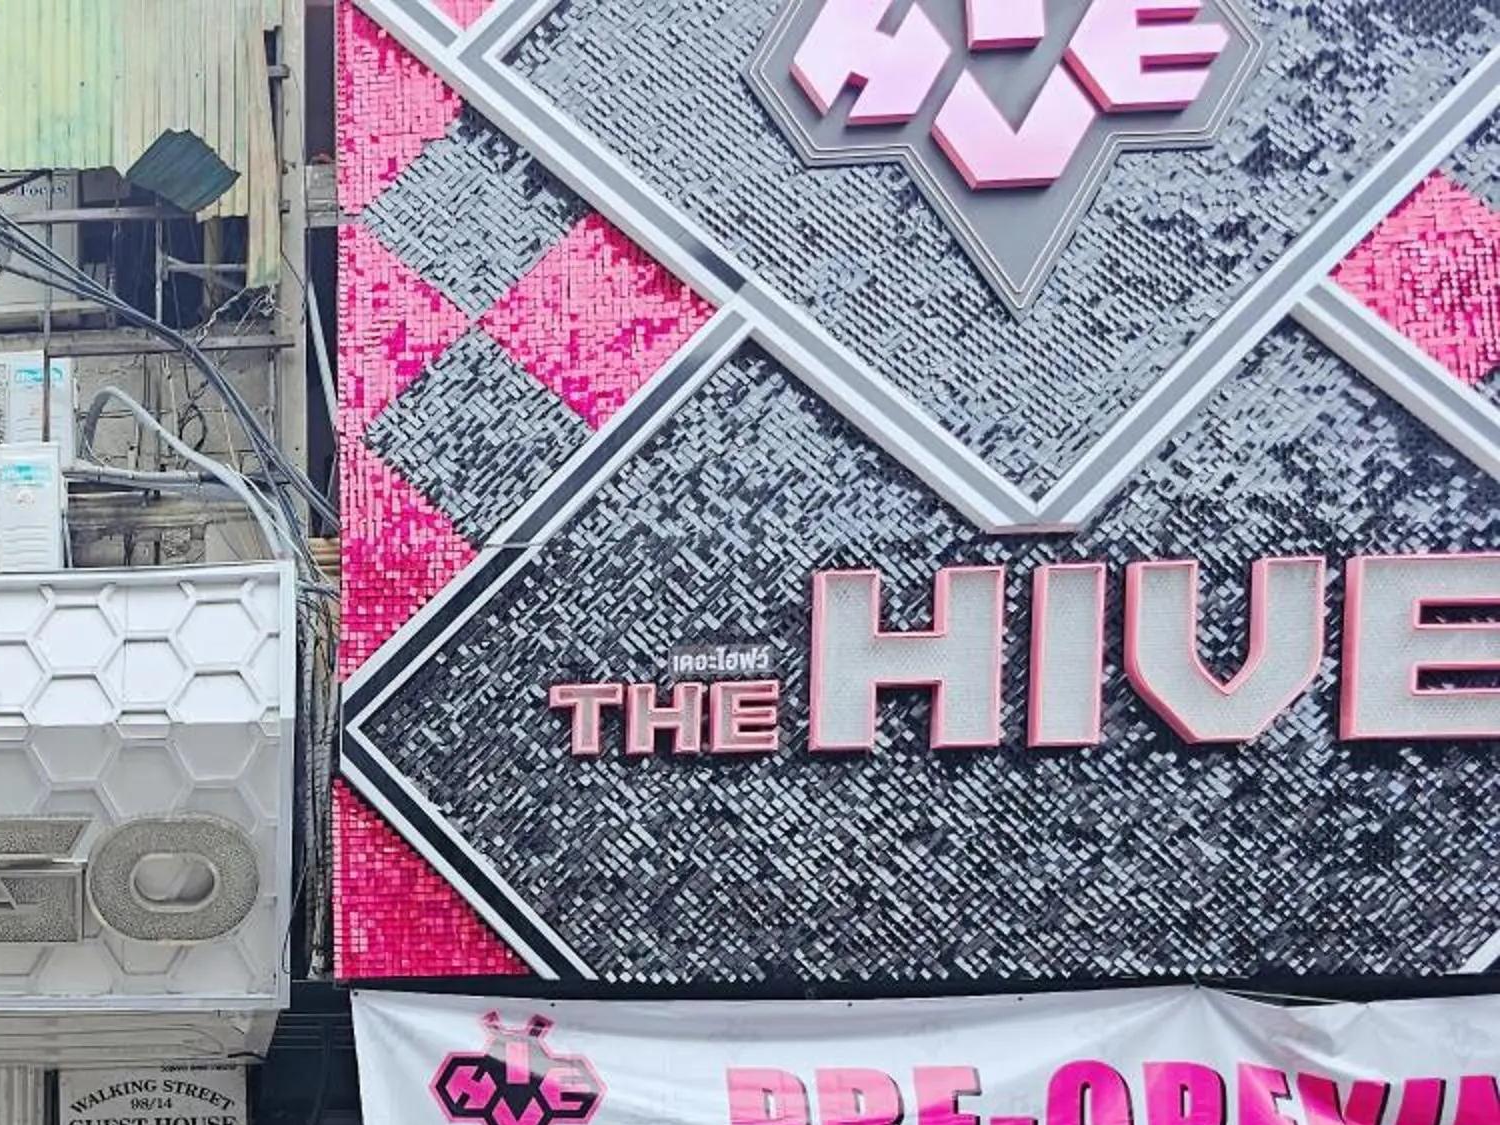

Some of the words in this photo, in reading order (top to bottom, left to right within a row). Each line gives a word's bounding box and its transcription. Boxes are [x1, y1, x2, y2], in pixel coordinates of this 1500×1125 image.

[549, 680, 780, 755] THE
[808, 553, 1500, 753] HIVE
[69, 1080, 158, 1114] WALKING
[162, 1079, 236, 1113] STREET
[130, 1097, 173, 1111] 98/14
